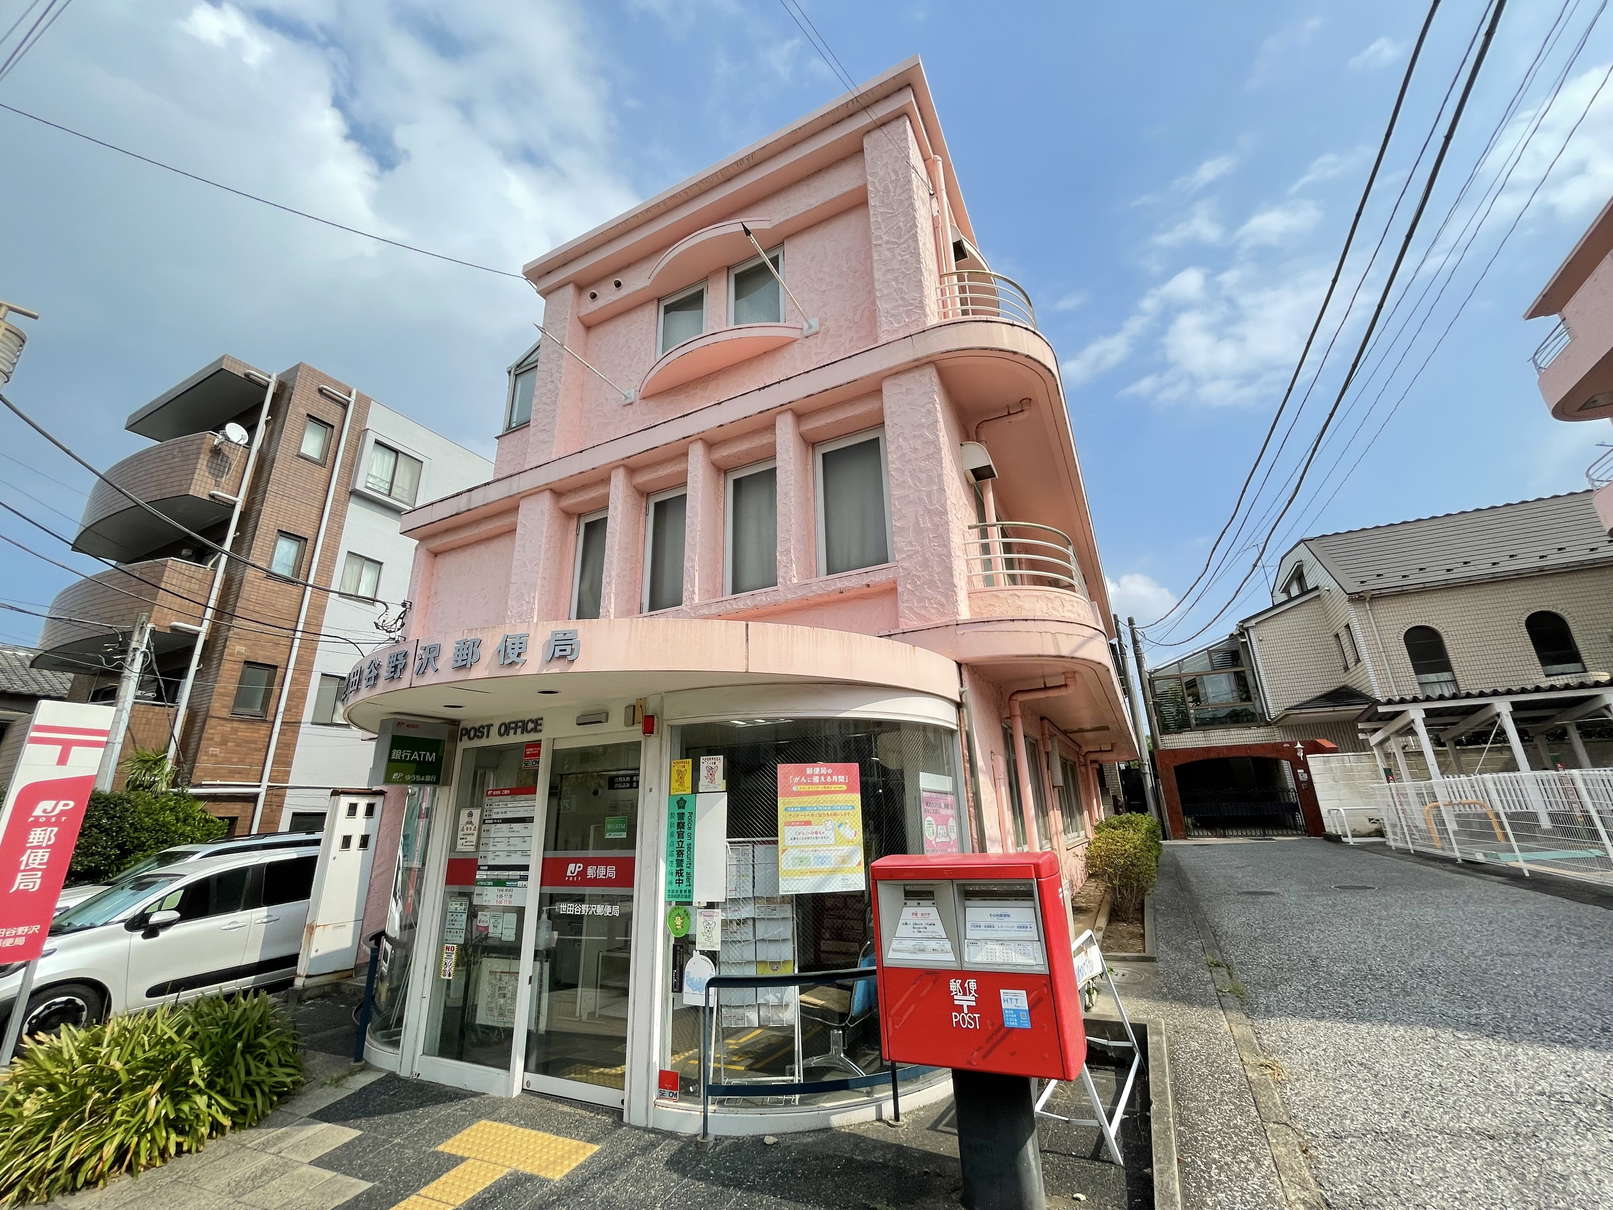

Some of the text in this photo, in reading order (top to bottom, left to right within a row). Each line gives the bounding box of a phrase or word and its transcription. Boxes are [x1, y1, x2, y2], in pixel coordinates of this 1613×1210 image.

[459, 717, 544, 742] POST OFFICE
[391, 748, 436, 762] 銀行ATM
[9, 827, 59, 894] 郵便局
[586, 865, 617, 880] 郵便局
[559, 903, 620, 917] 世田谷野沢郵便局
[949, 979, 979, 998] 郵便
[951, 1012, 981, 1030] POST
